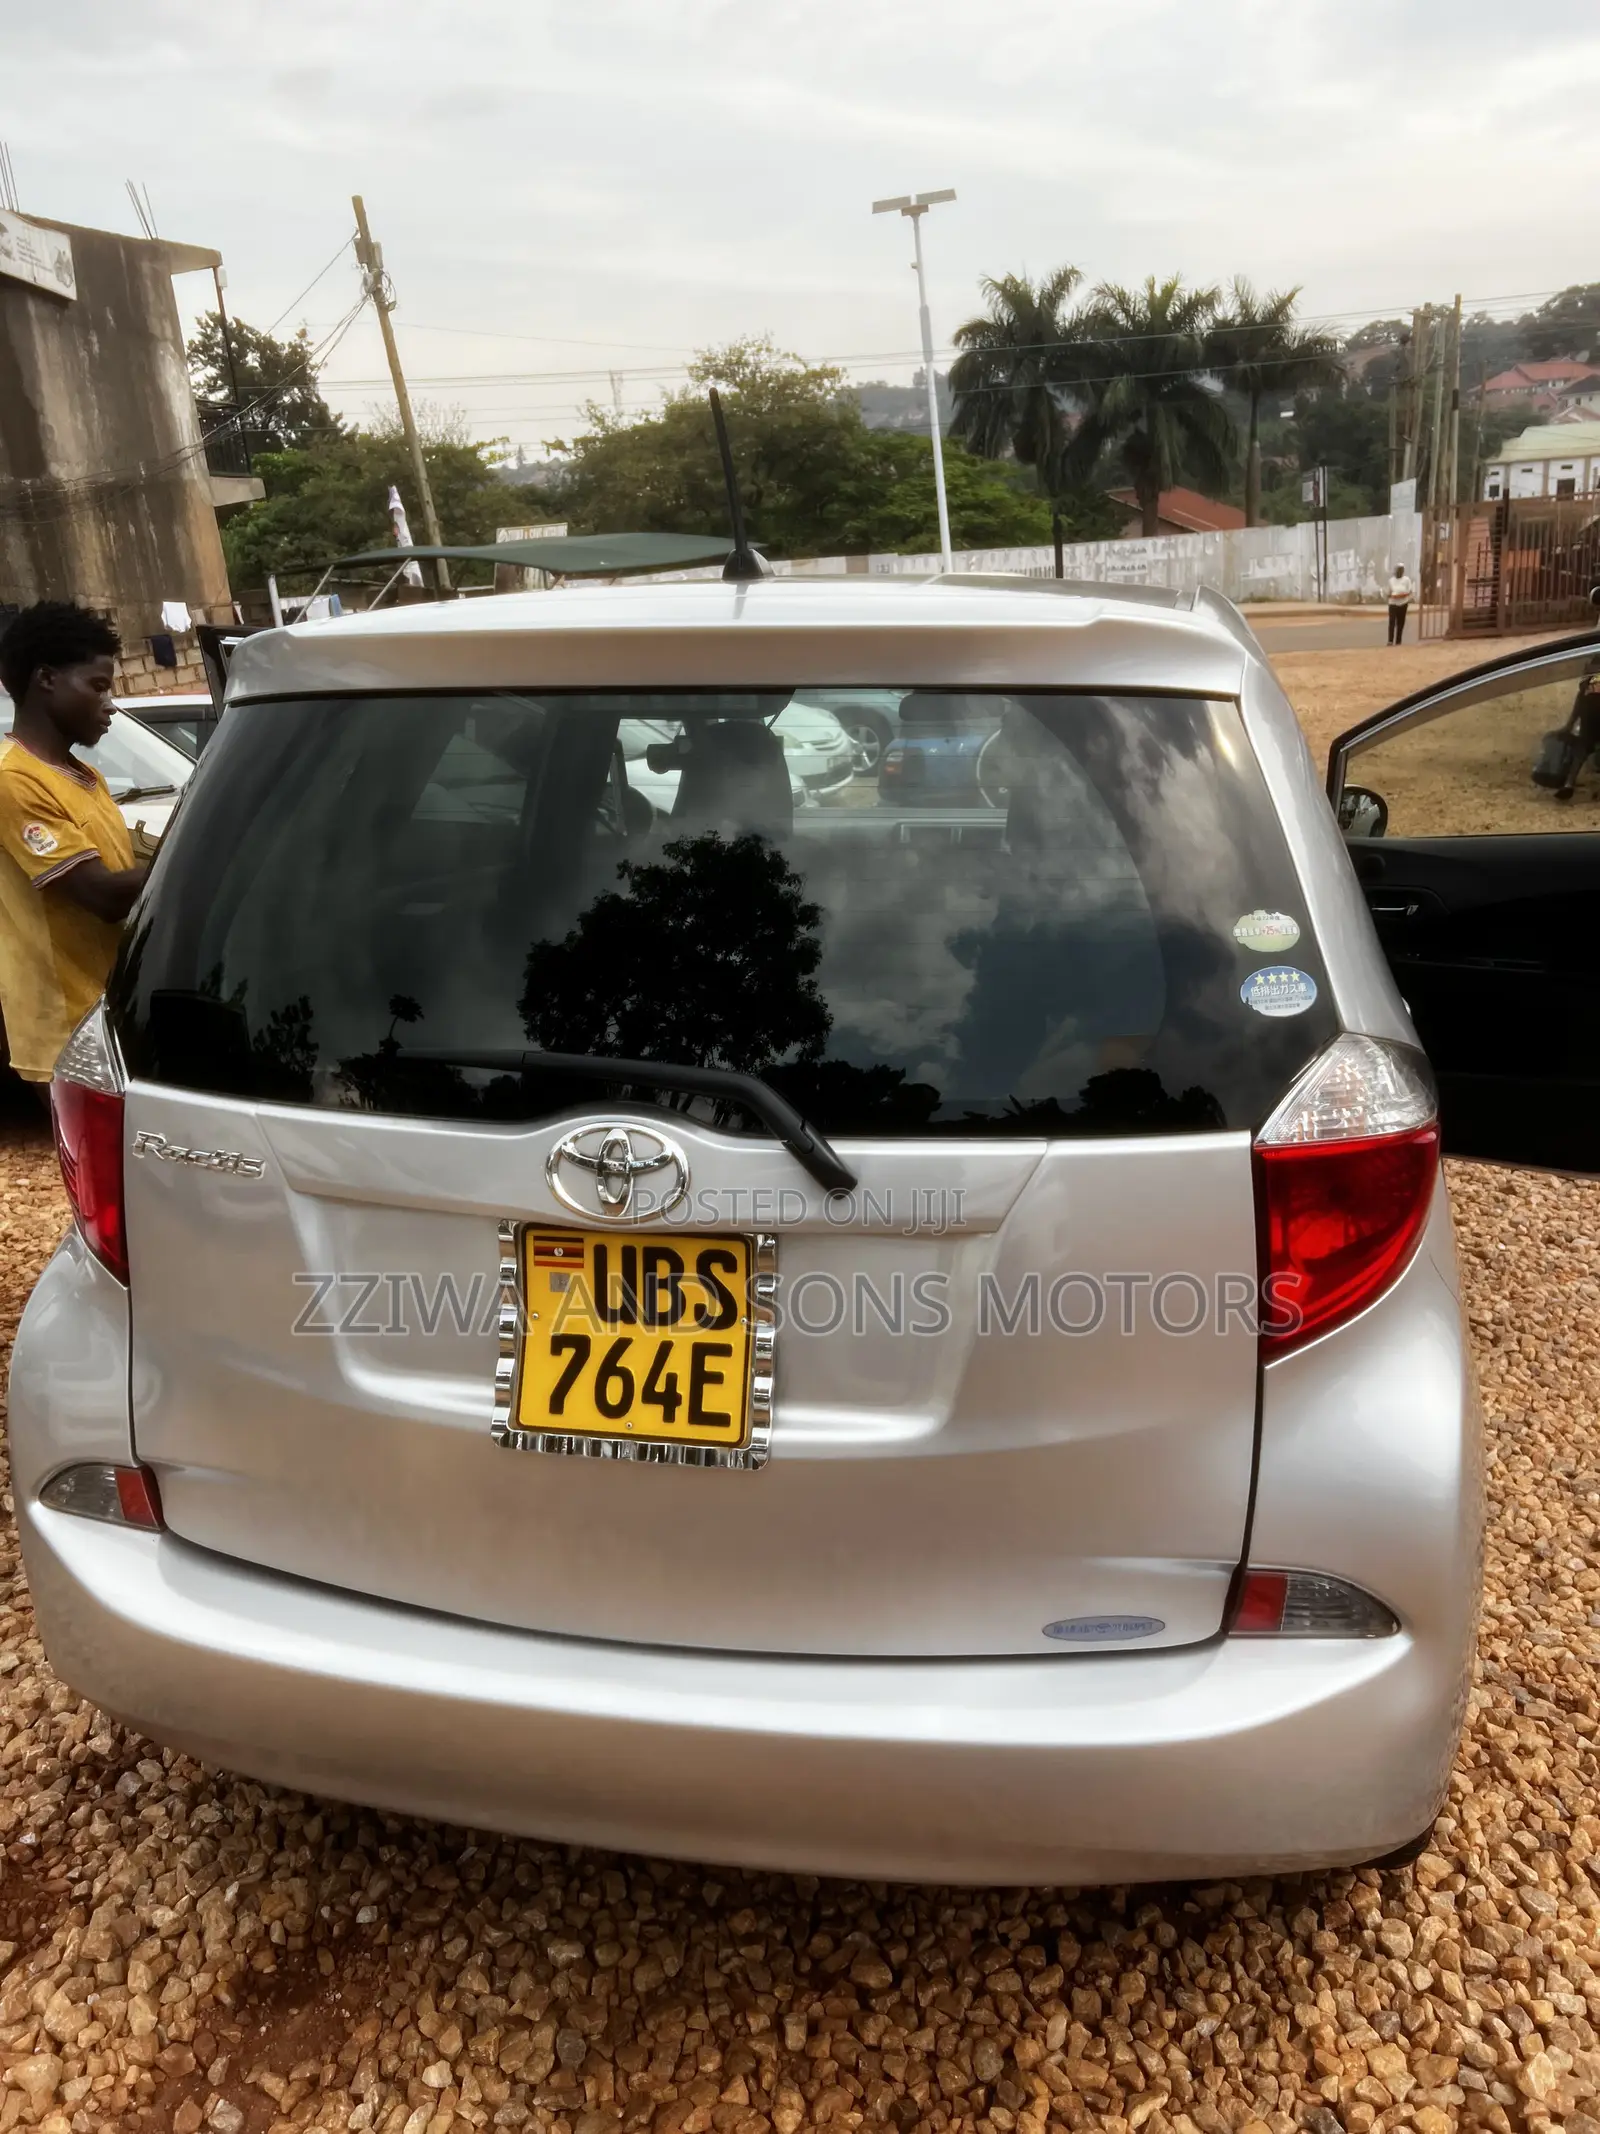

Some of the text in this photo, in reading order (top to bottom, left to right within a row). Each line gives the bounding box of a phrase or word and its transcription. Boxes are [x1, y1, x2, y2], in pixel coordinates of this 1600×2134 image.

[1250, 982, 1307, 997] 低排出ガス車
[132, 1131, 266, 1179] Ractis
[593, 1244, 738, 1331] UBS
[548, 1333, 733, 1428] 764E
